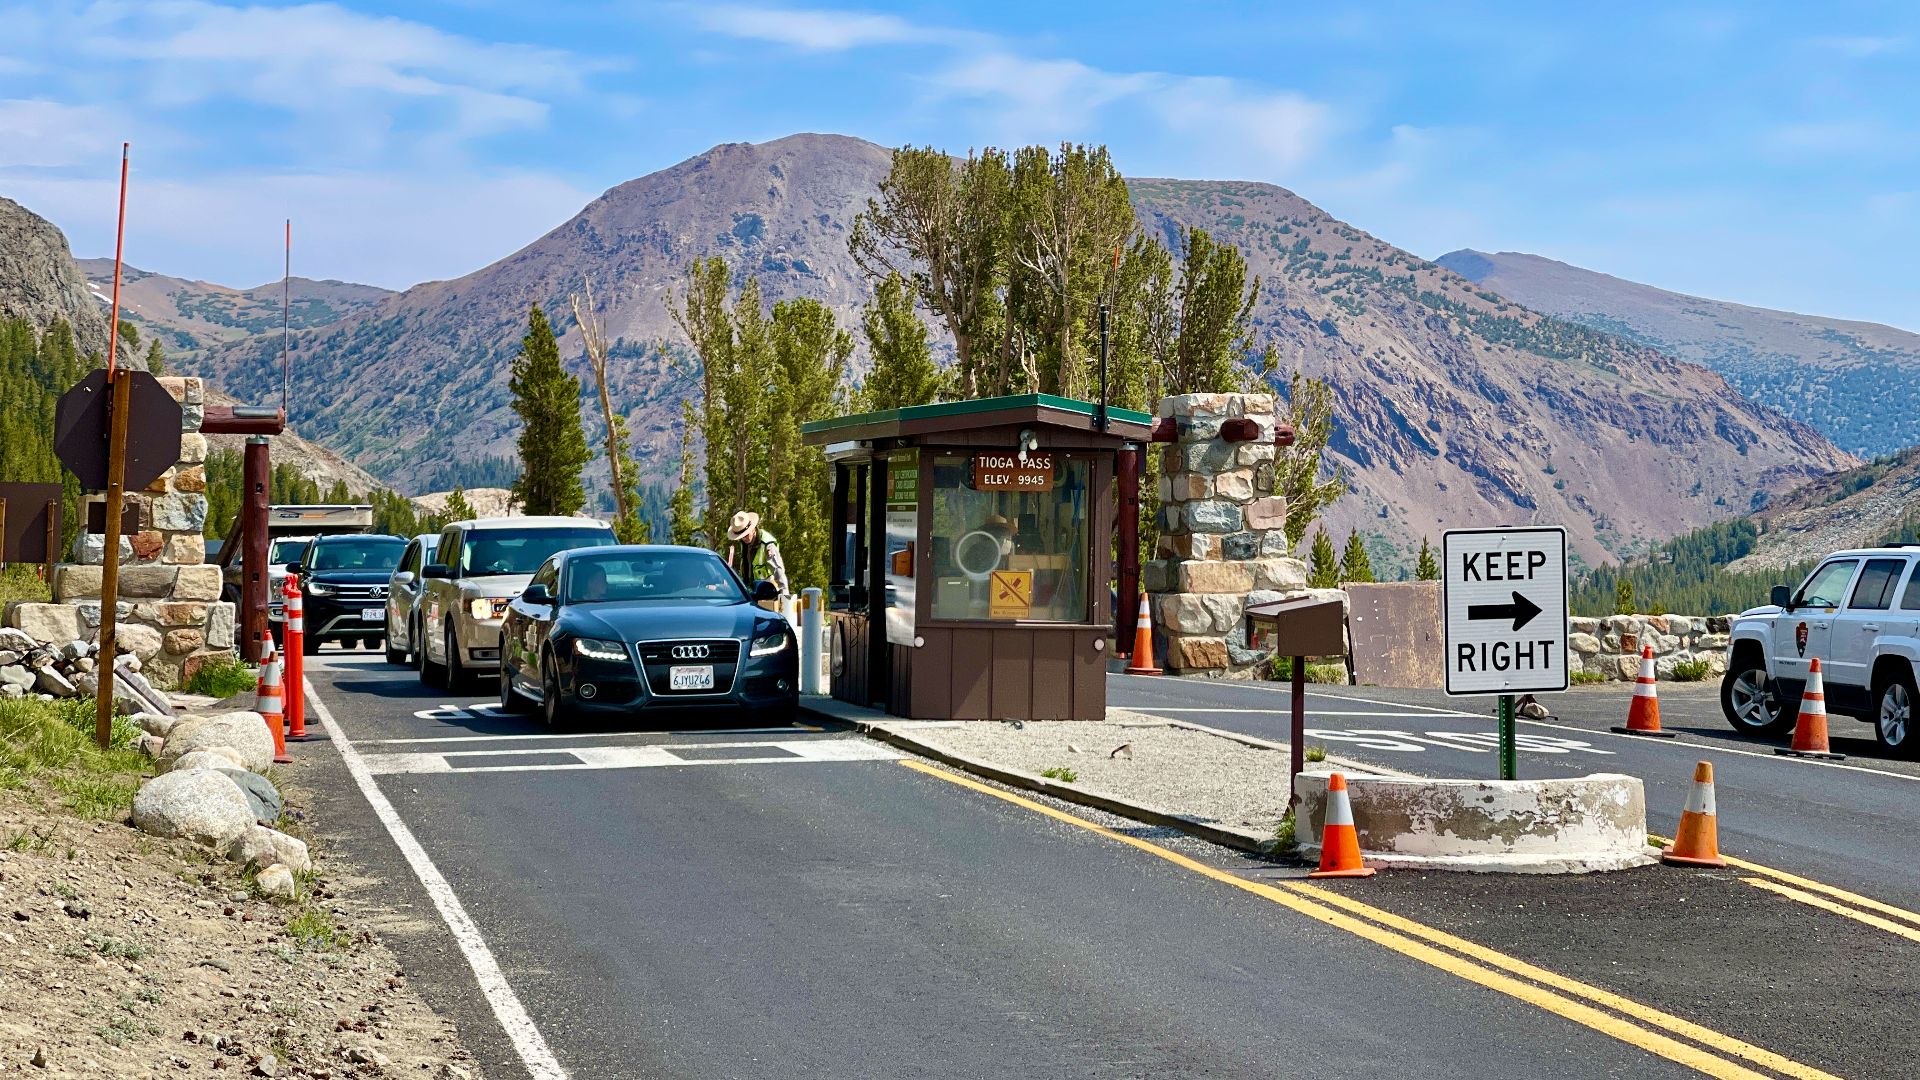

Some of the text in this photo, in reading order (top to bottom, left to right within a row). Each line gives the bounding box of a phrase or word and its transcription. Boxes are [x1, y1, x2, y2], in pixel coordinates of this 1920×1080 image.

[979, 456, 1051, 470] TIOGA PASS
[984, 474, 1044, 486] ELEV. 9945
[1463, 551, 1547, 581] KEEP
[1458, 641, 1555, 672] RIGHT
[1303, 728, 1616, 755] STOP
